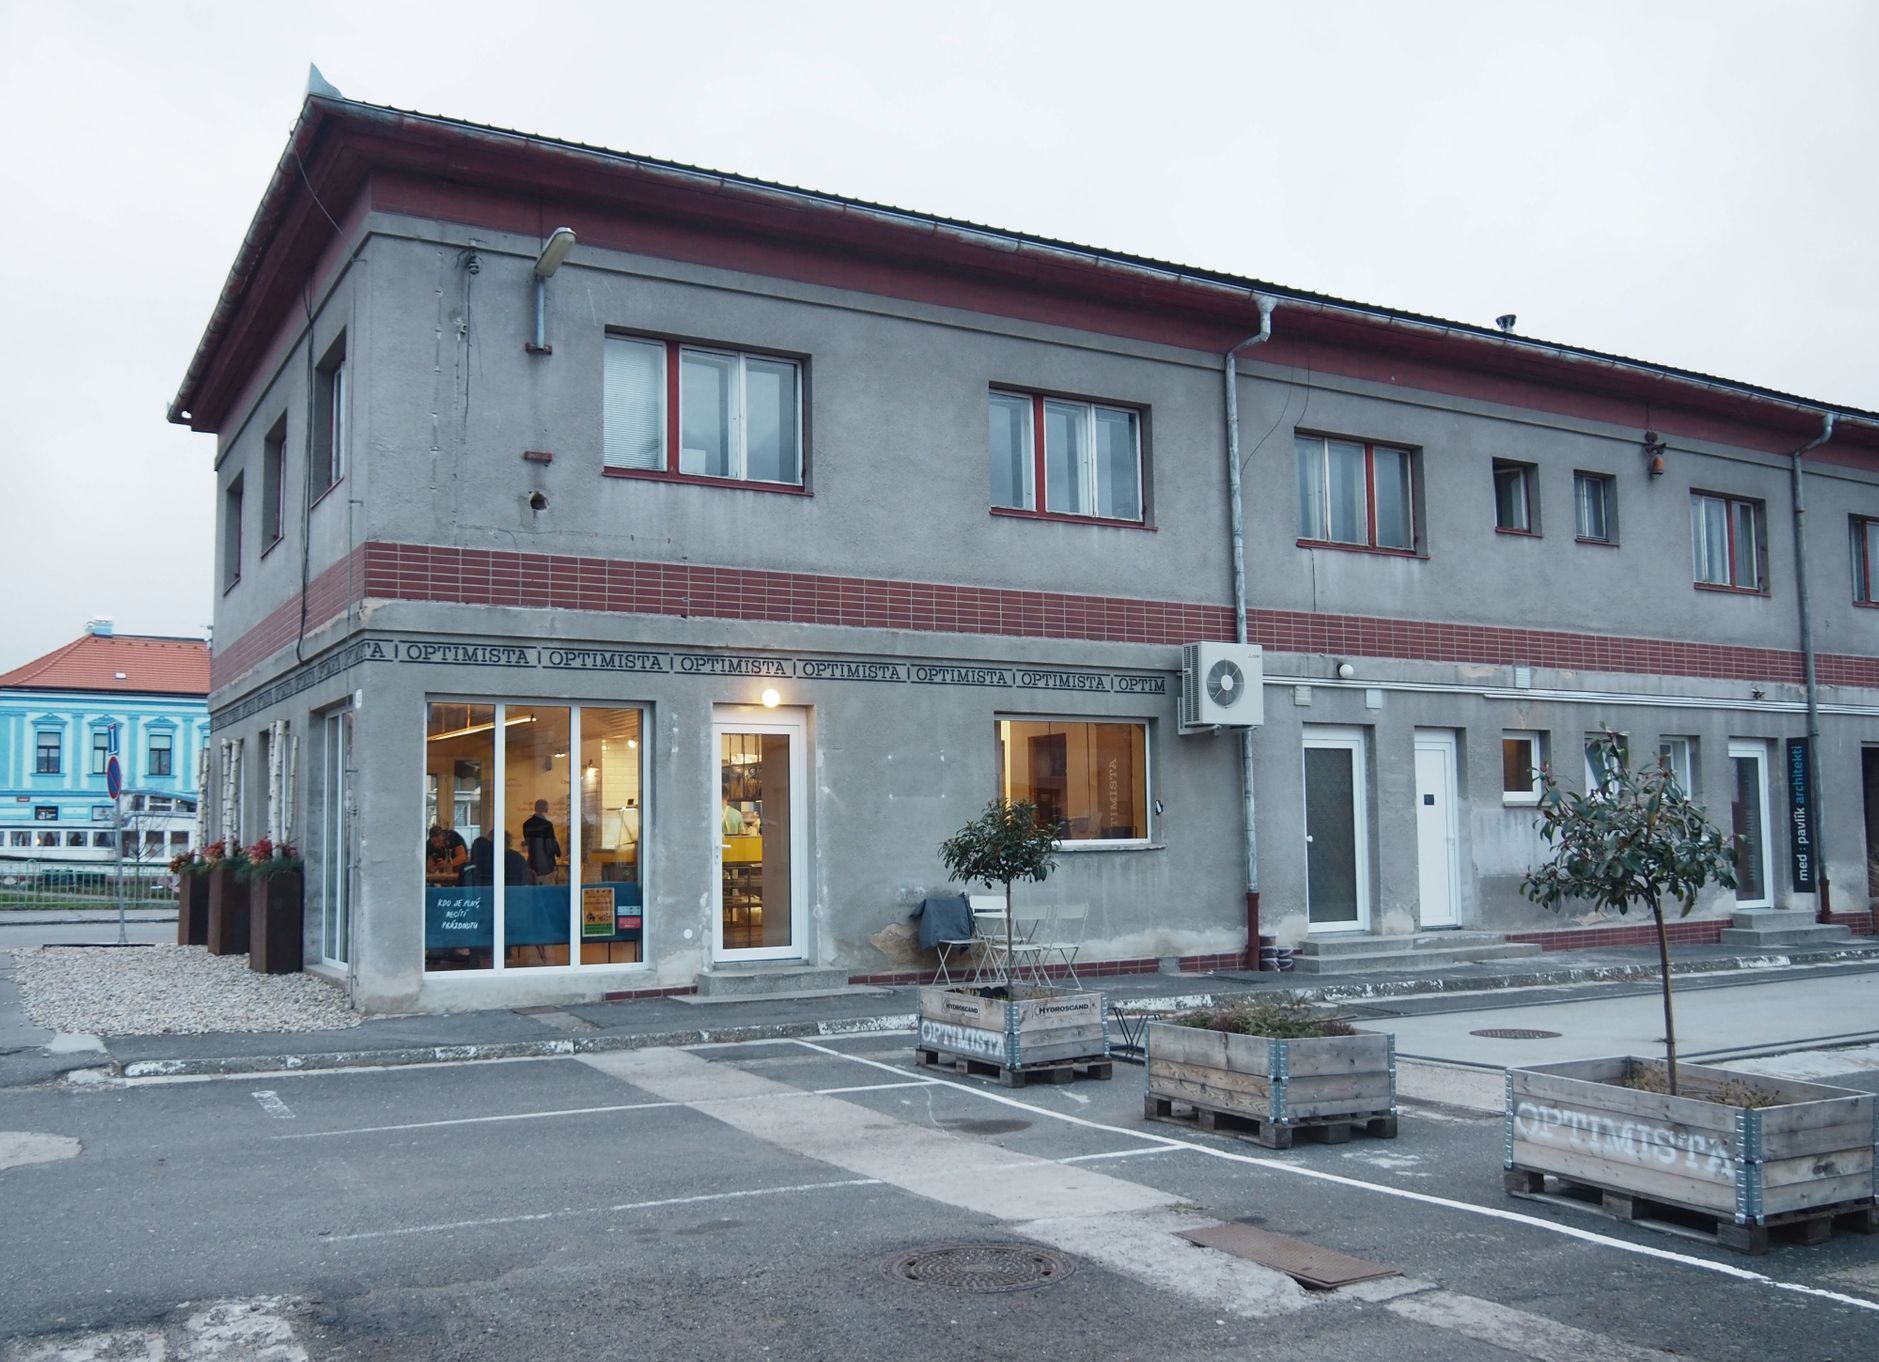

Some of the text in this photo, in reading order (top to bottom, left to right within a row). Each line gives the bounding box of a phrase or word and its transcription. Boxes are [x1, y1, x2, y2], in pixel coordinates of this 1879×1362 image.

[406, 644, 530, 664] OPTIMISTA
[549, 650, 664, 670] OPTIMISTA
[680, 656, 787, 675] OPTIMISTA
[802, 662, 901, 680] OPTIMISTA
[915, 667, 1008, 685] OPTIMISTA
[1021, 672, 1106, 689] OPTIMISTA
[1118, 678, 1166, 692] OPTIM
[1791, 746, 1805, 804] architekti
[1794, 807, 1809, 844] pavlík
[1796, 854, 1808, 881] med
[437, 898, 452, 907] KDO
[453, 898, 463, 907] JE
[945, 1001, 979, 1014] HYDROSCAND
[1038, 1003, 1089, 1015] HYDROSCAND
[921, 1020, 1006, 1058] OPTIMISTA
[1515, 1102, 1738, 1180] OPTIMISTA
